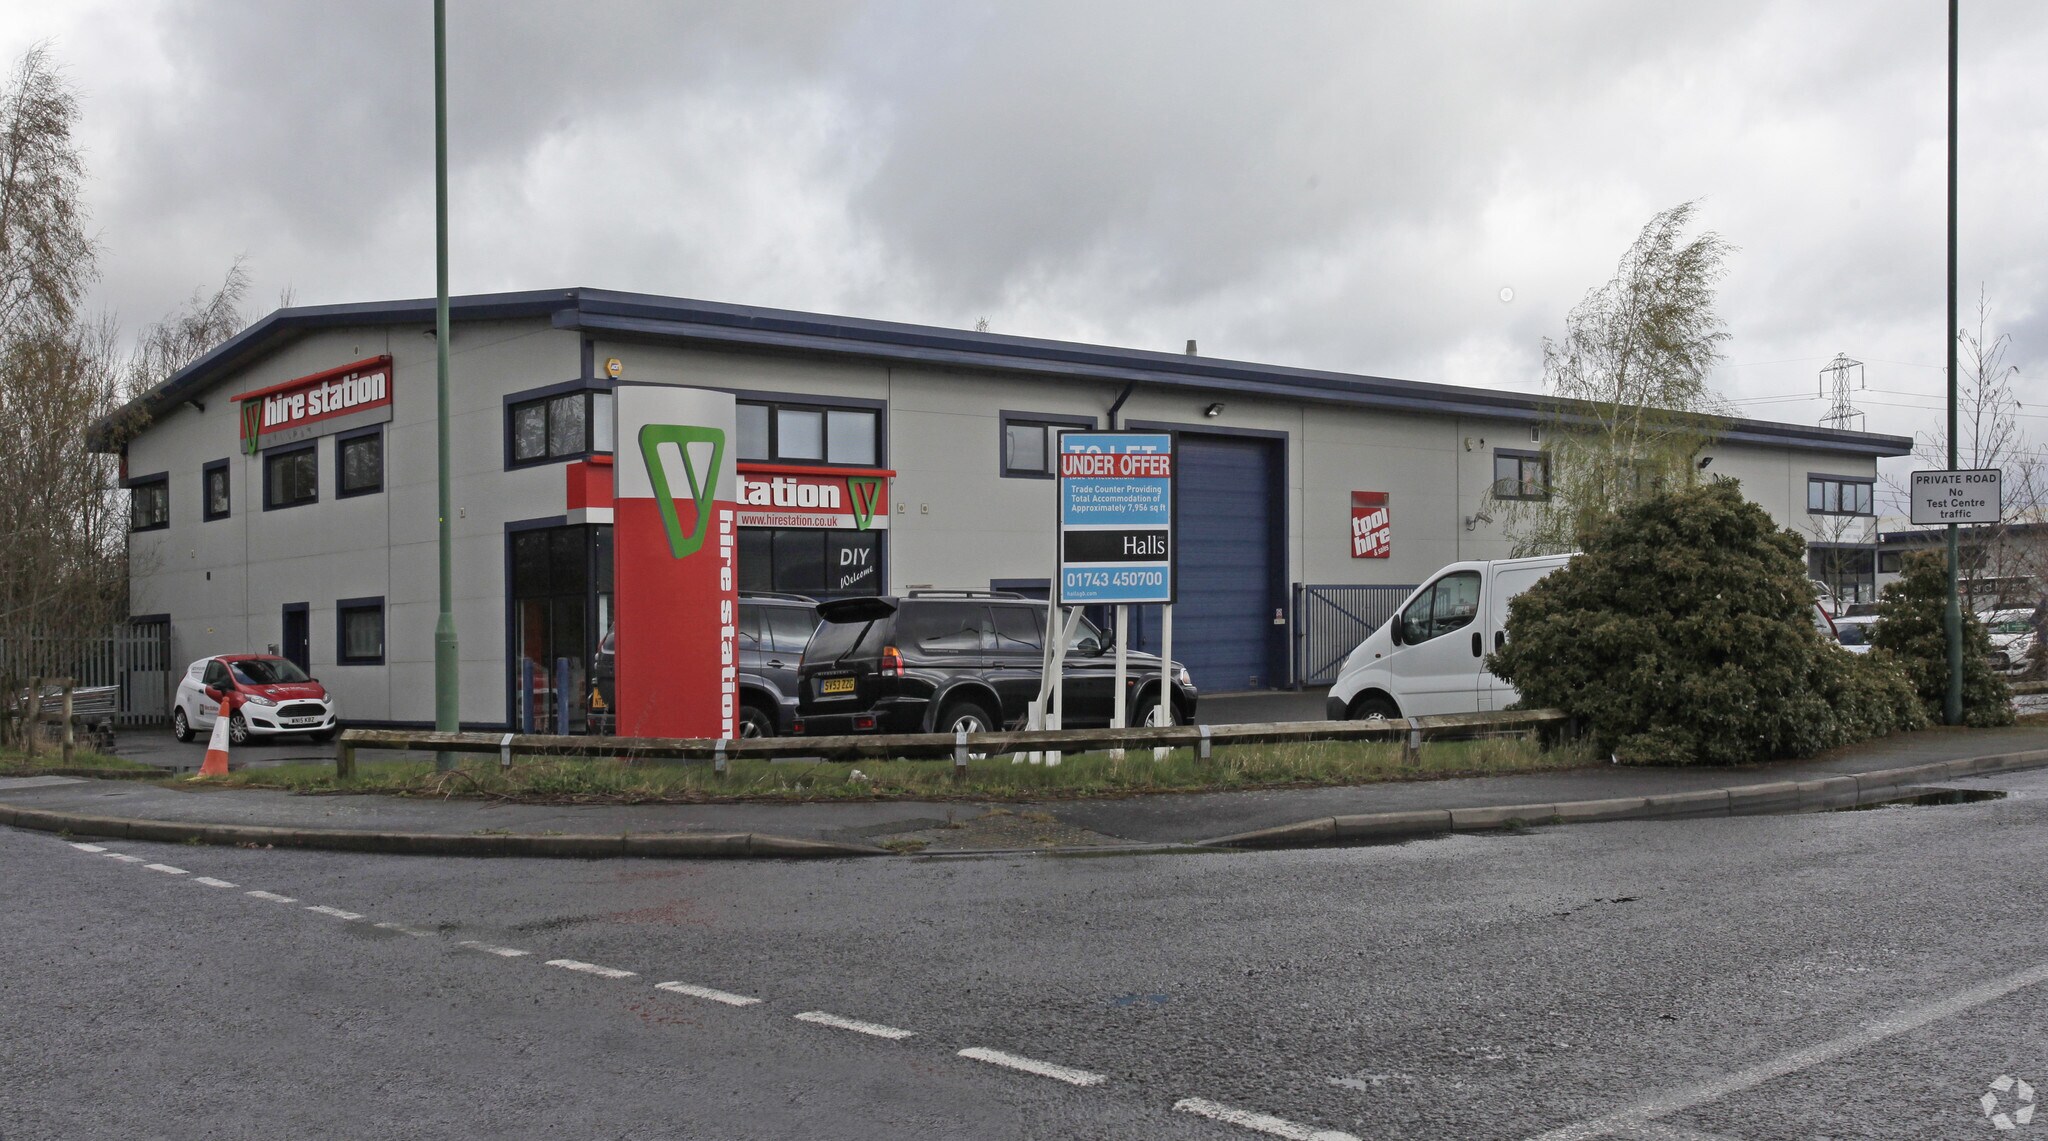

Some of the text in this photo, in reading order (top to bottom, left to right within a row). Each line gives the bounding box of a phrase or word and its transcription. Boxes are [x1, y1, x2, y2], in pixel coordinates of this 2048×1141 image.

[264, 373, 386, 427] hire station
[1062, 455, 1170, 475] UNDER OFFER
[1916, 474, 1996, 484] PRIVATE ROAD
[736, 475, 840, 509] tation
[1072, 485, 1162, 494] Trade Counter Providing
[1949, 488, 1963, 496] No
[1072, 504, 1166, 514] Approximately 7,956 sq ft
[1951, 499, 1985, 507] Centre
[741, 514, 838, 527] www.hirestation.co.uk
[1353, 508, 1388, 536] tool
[1940, 510, 1971, 518] traffic
[1124, 535, 1165, 554] Halls
[1354, 527, 1390, 556] hire
[1378, 545, 1389, 554] sales
[720, 510, 734, 591] hire
[840, 548, 869, 566] DIY
[840, 566, 873, 589] Welcome
[1067, 571, 1162, 587] 01743 450700
[721, 600, 736, 739] station
[825, 681, 840, 690] SV53
